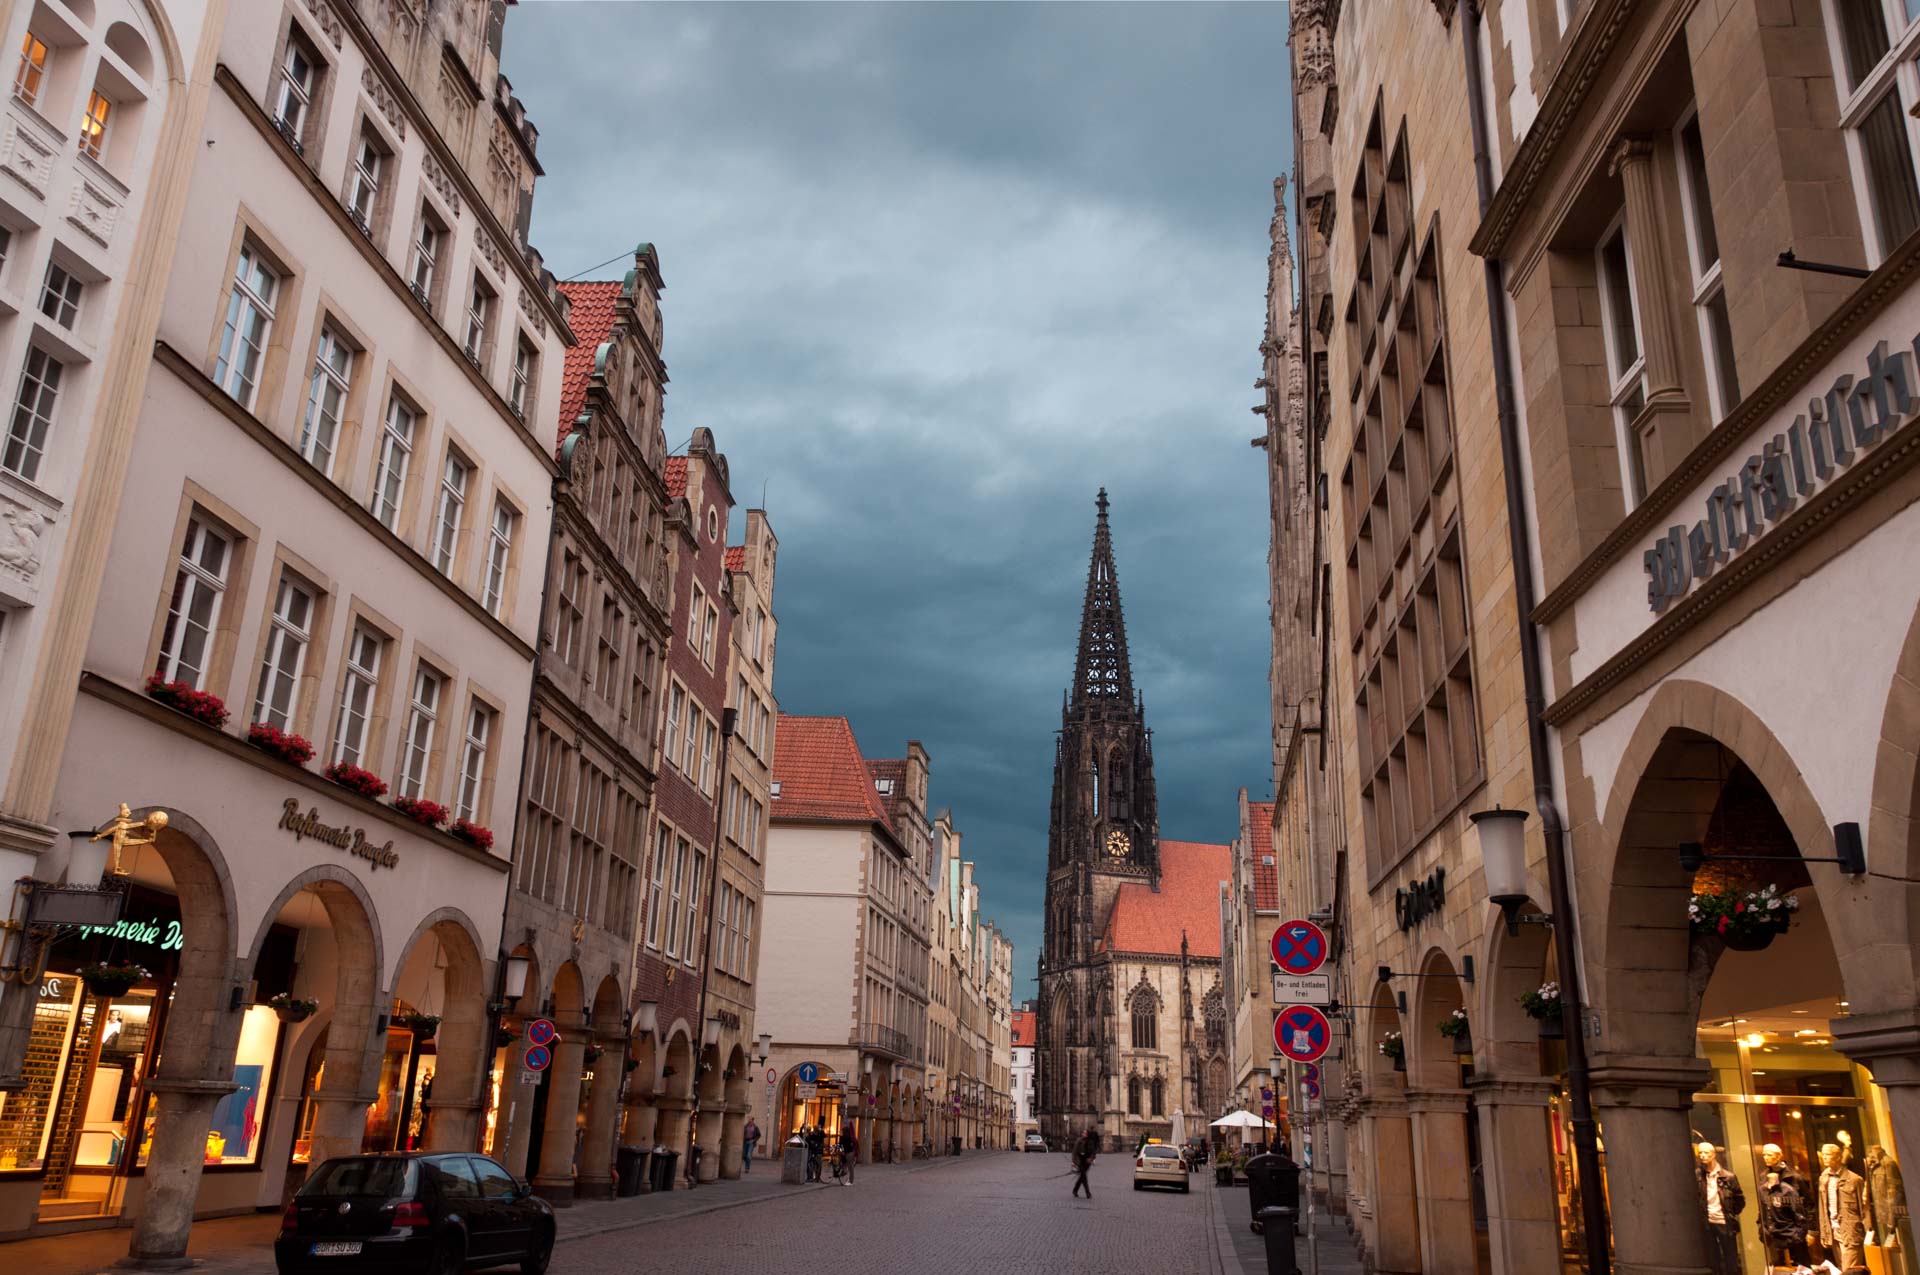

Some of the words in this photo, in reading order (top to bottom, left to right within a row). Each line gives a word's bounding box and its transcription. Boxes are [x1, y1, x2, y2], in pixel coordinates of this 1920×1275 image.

[278, 797, 352, 850] Parfümerie
[351, 828, 400, 872] Douglas
[1276, 980, 1287, 988] Be-
[1289, 980, 1300, 988] und
[1301, 980, 1326, 988] Entladen
[1295, 989, 1308, 997] frei
